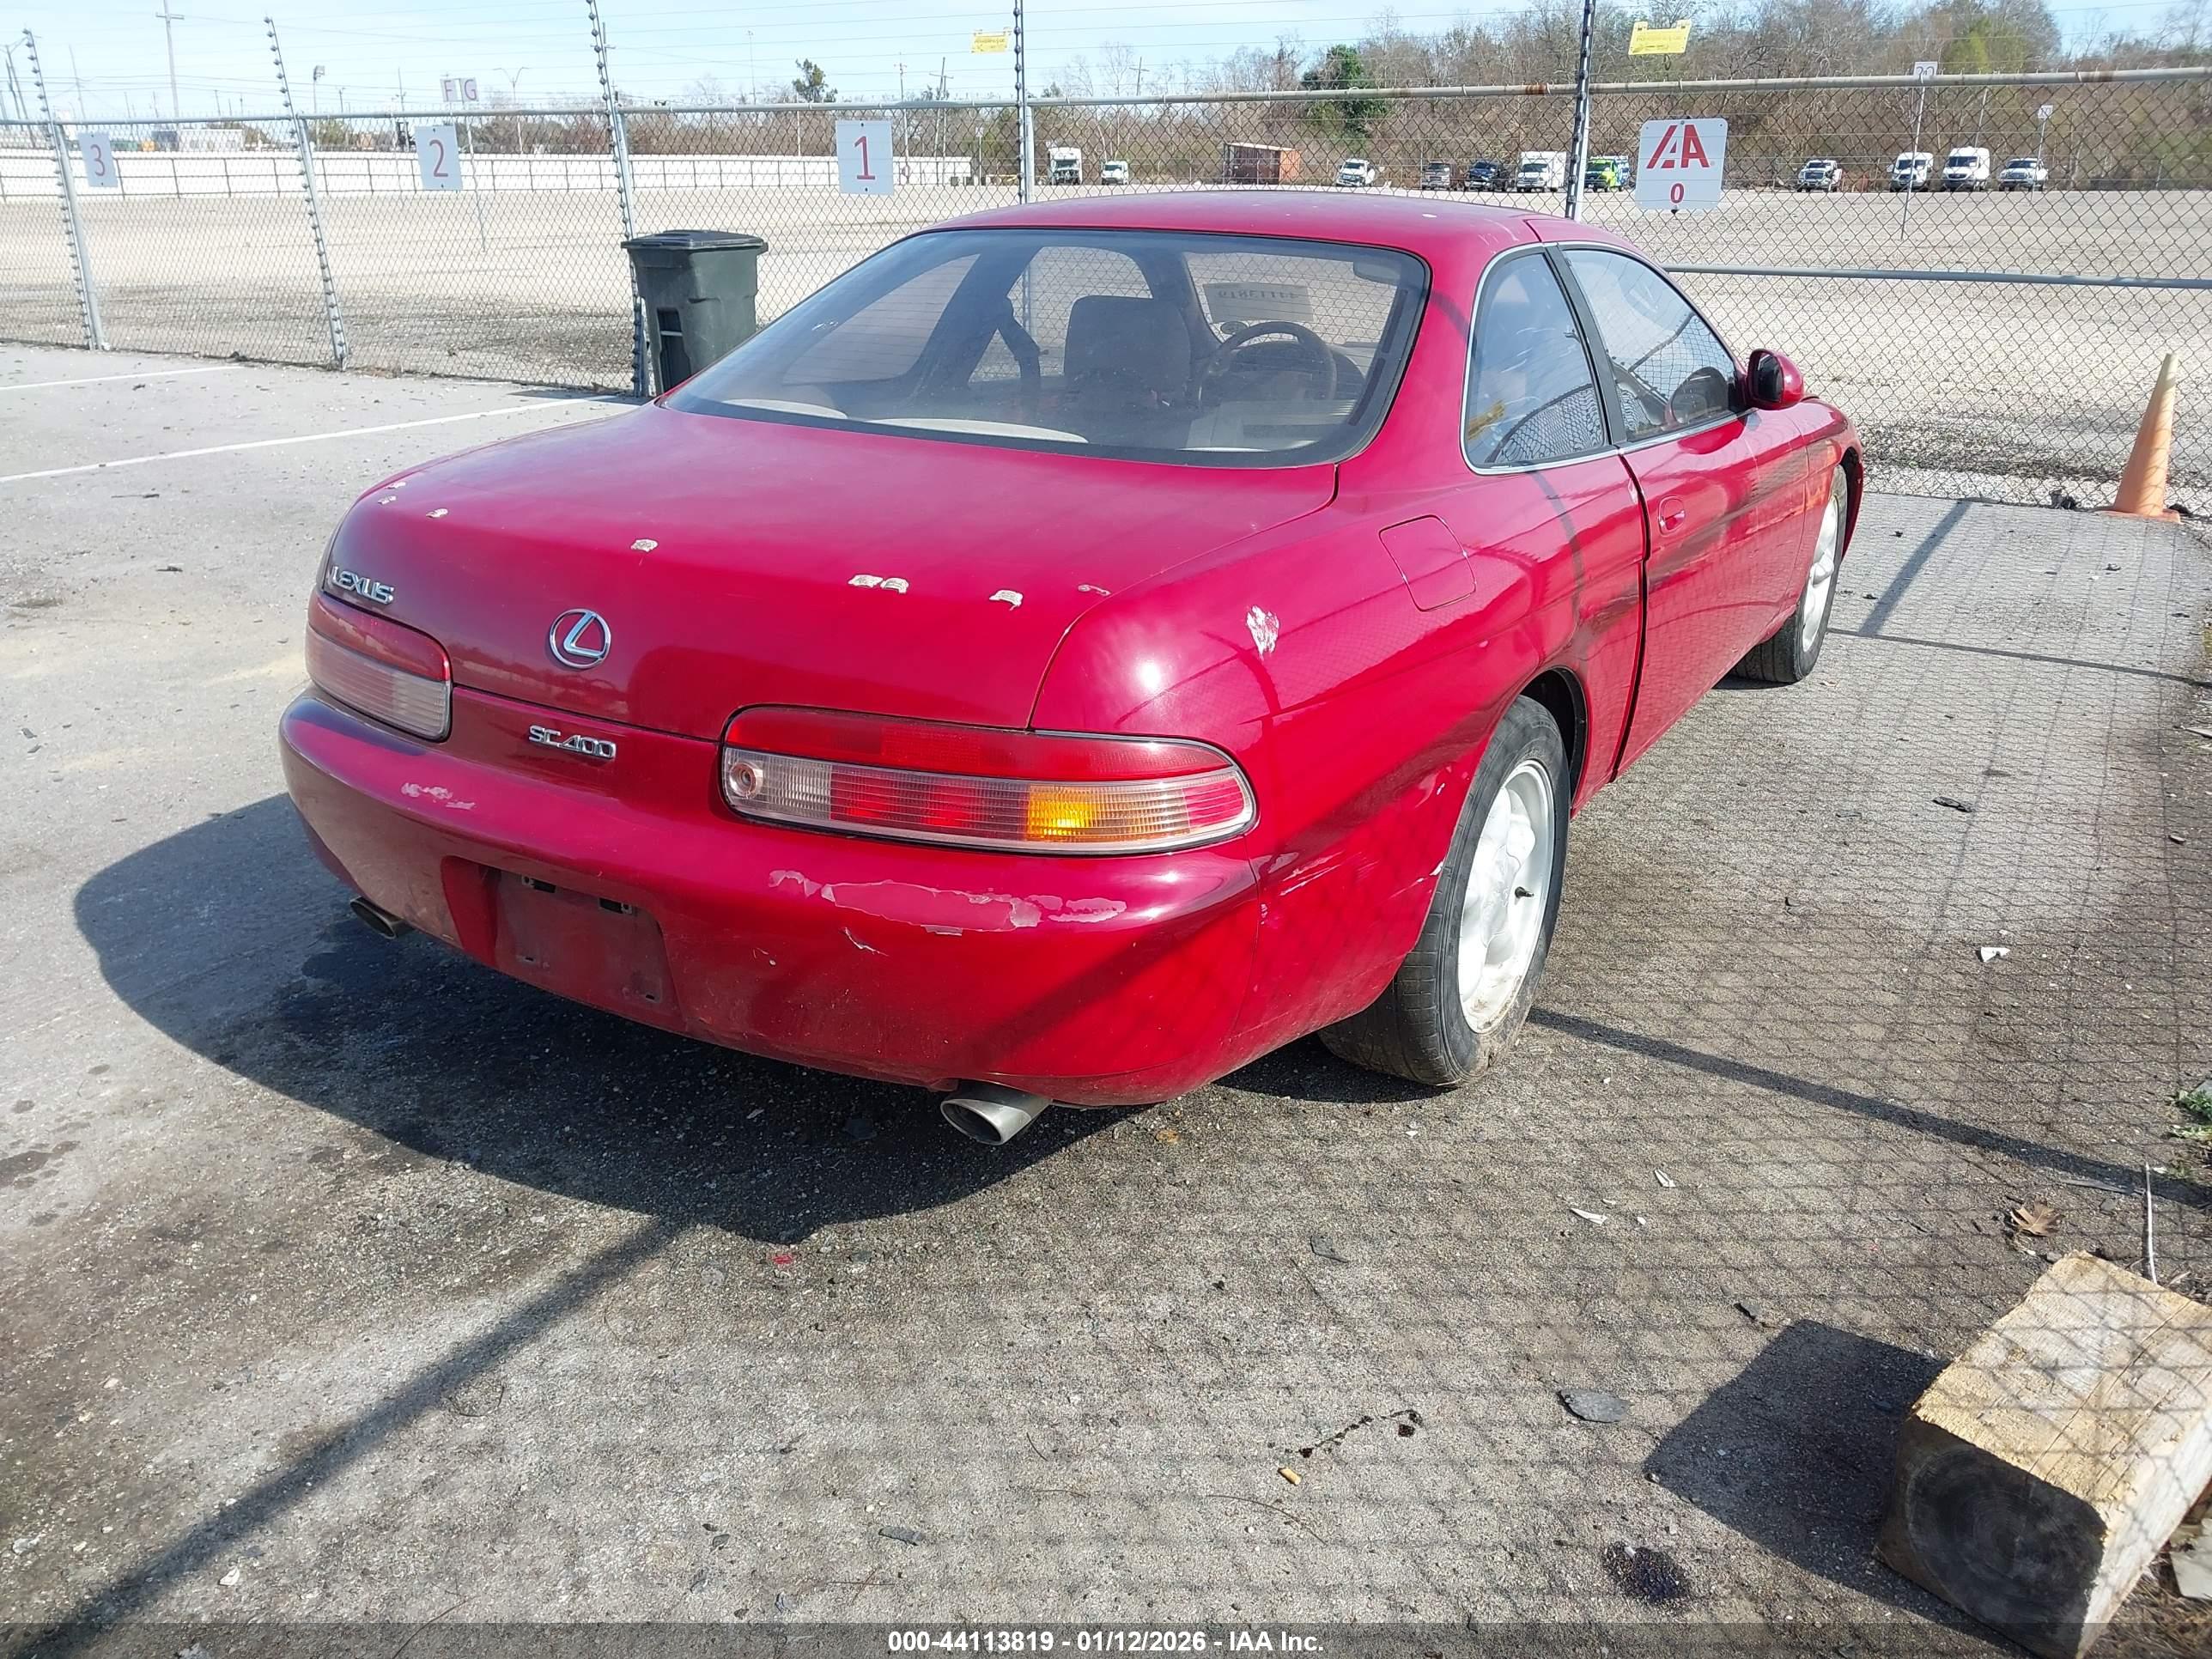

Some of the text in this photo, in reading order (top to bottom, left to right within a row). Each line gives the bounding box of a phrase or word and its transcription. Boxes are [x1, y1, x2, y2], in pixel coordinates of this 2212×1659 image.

[443, 80, 452, 101] F
[464, 79, 477, 100] G
[90, 144, 105, 176] 3
[429, 139, 448, 177] 2
[854, 136, 875, 179] 1
[1670, 183, 1684, 204] 0
[331, 566, 394, 605] LEXUS
